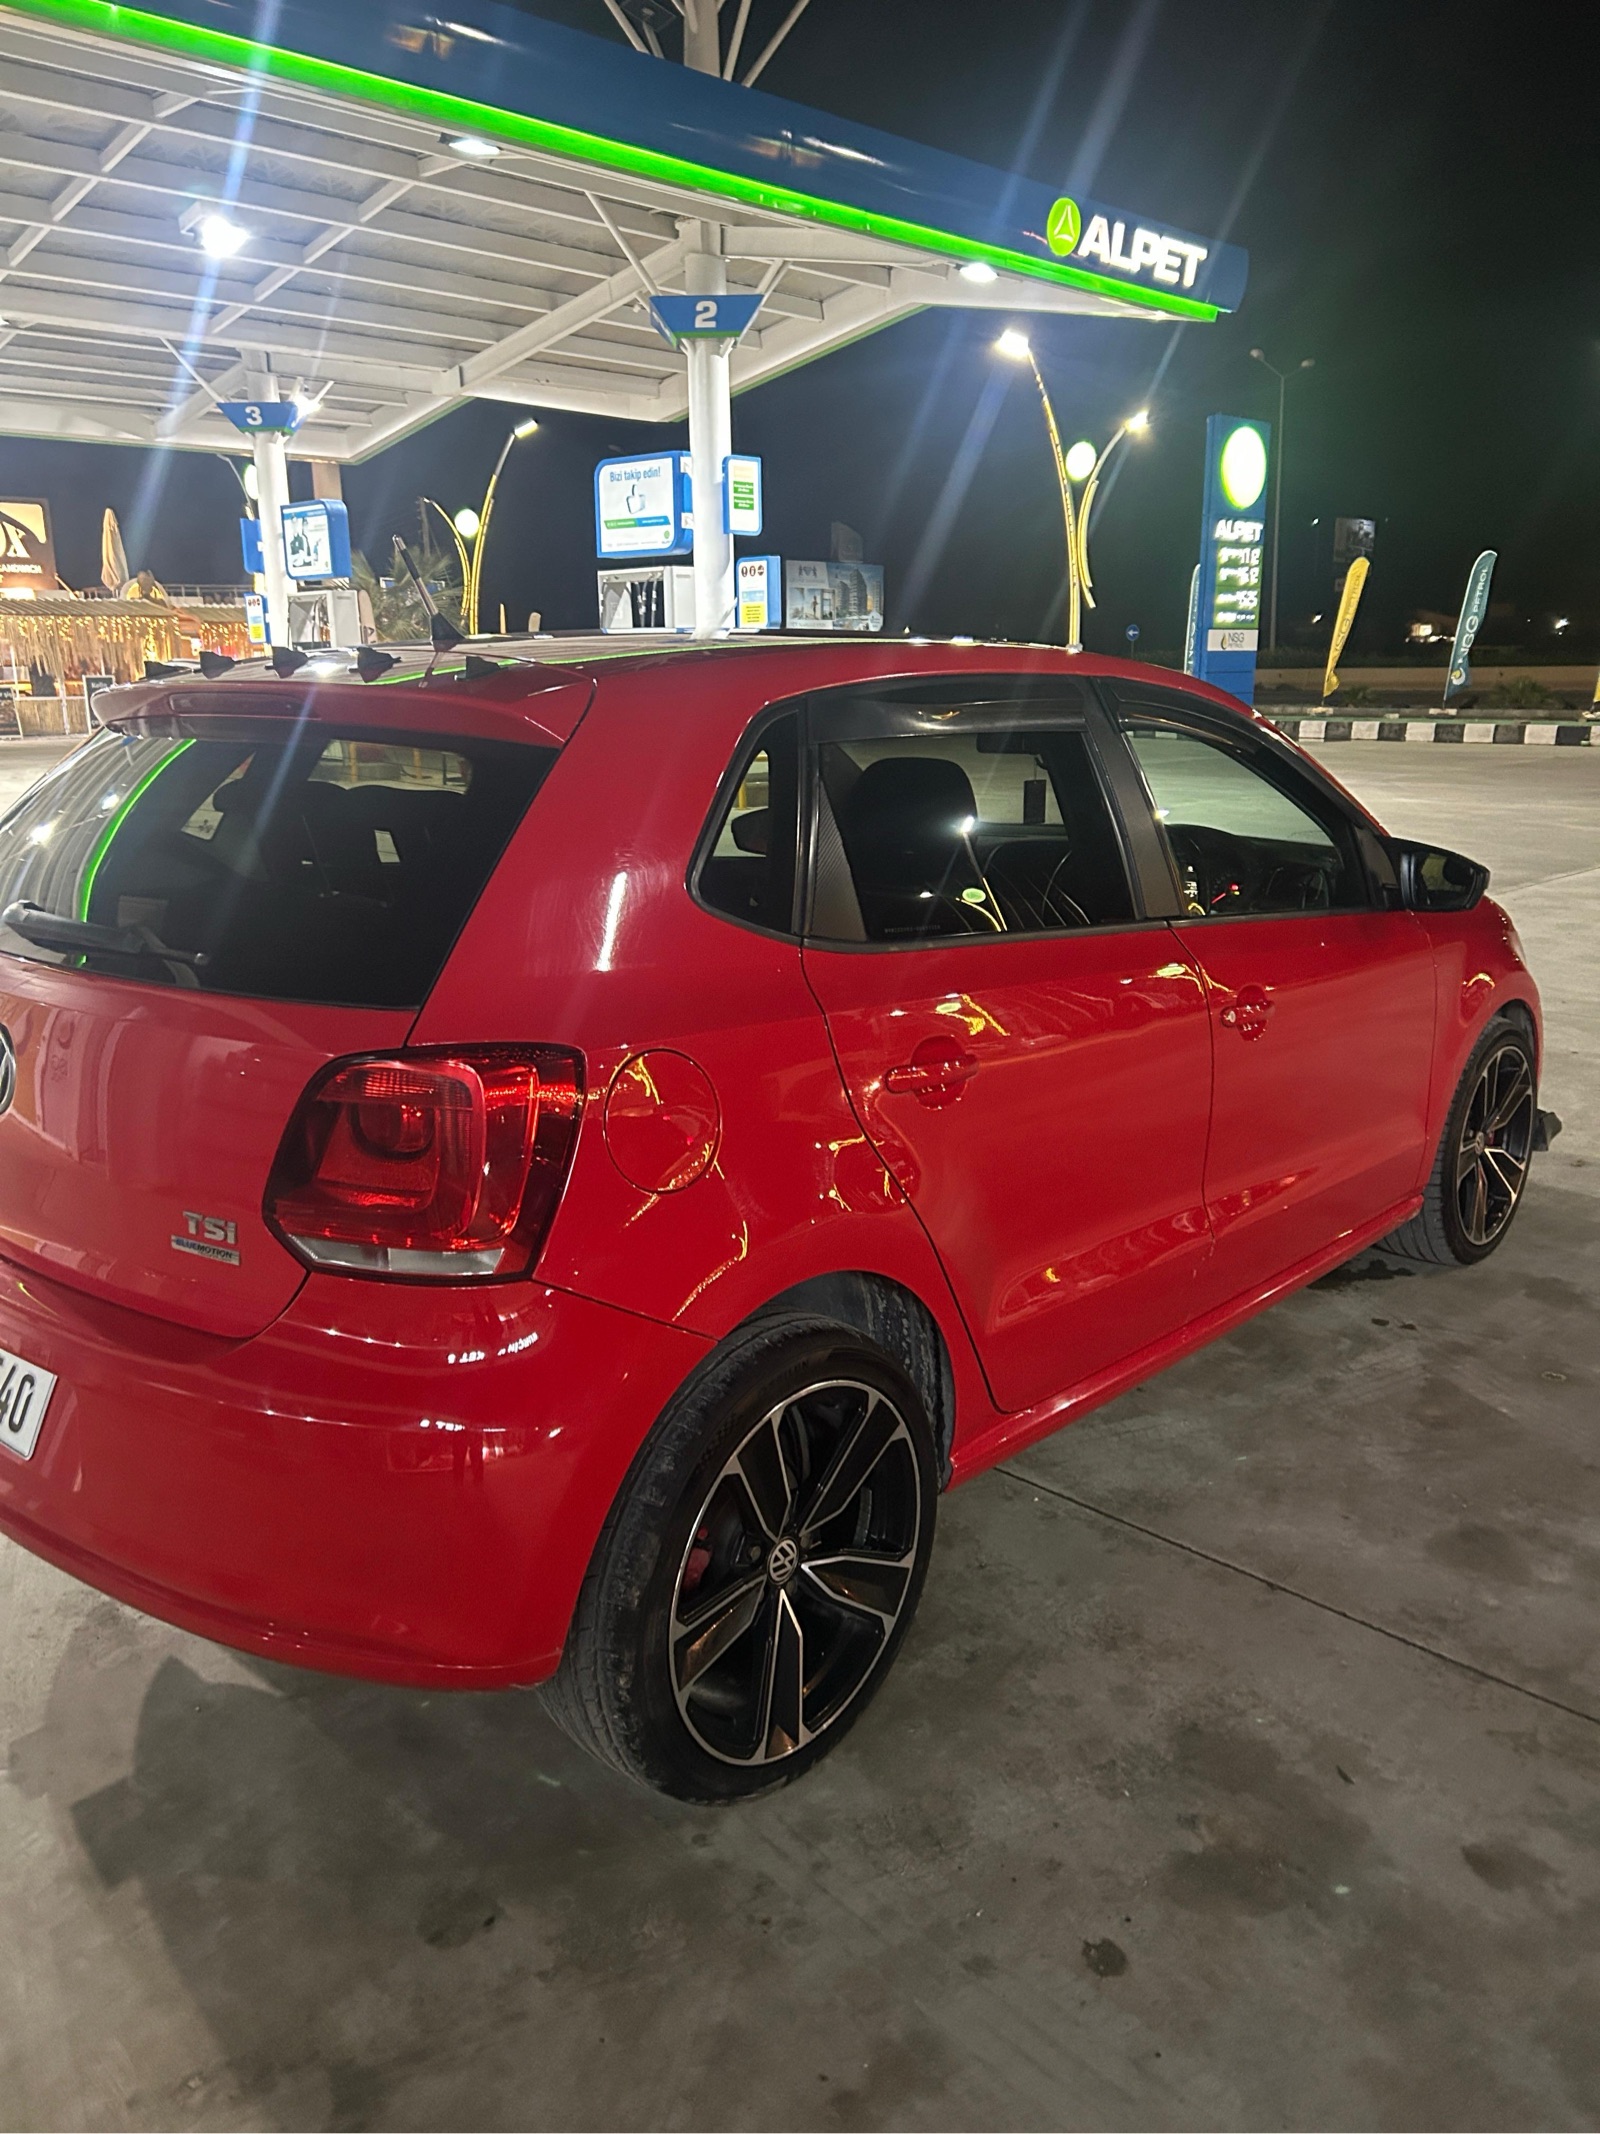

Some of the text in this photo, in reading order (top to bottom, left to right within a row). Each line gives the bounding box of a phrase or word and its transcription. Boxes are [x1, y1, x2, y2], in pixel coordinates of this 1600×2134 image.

[1077, 213, 1208, 289] ALPET
[694, 300, 718, 329] 2
[245, 405, 263, 426] 3
[609, 465, 661, 482] Bizi takip edin!
[1214, 518, 1264, 542] ALPET
[1473, 566, 1488, 613] PETROL
[1228, 632, 1245, 643] NSG
[175, 1238, 233, 1259] BLUEMOTION
